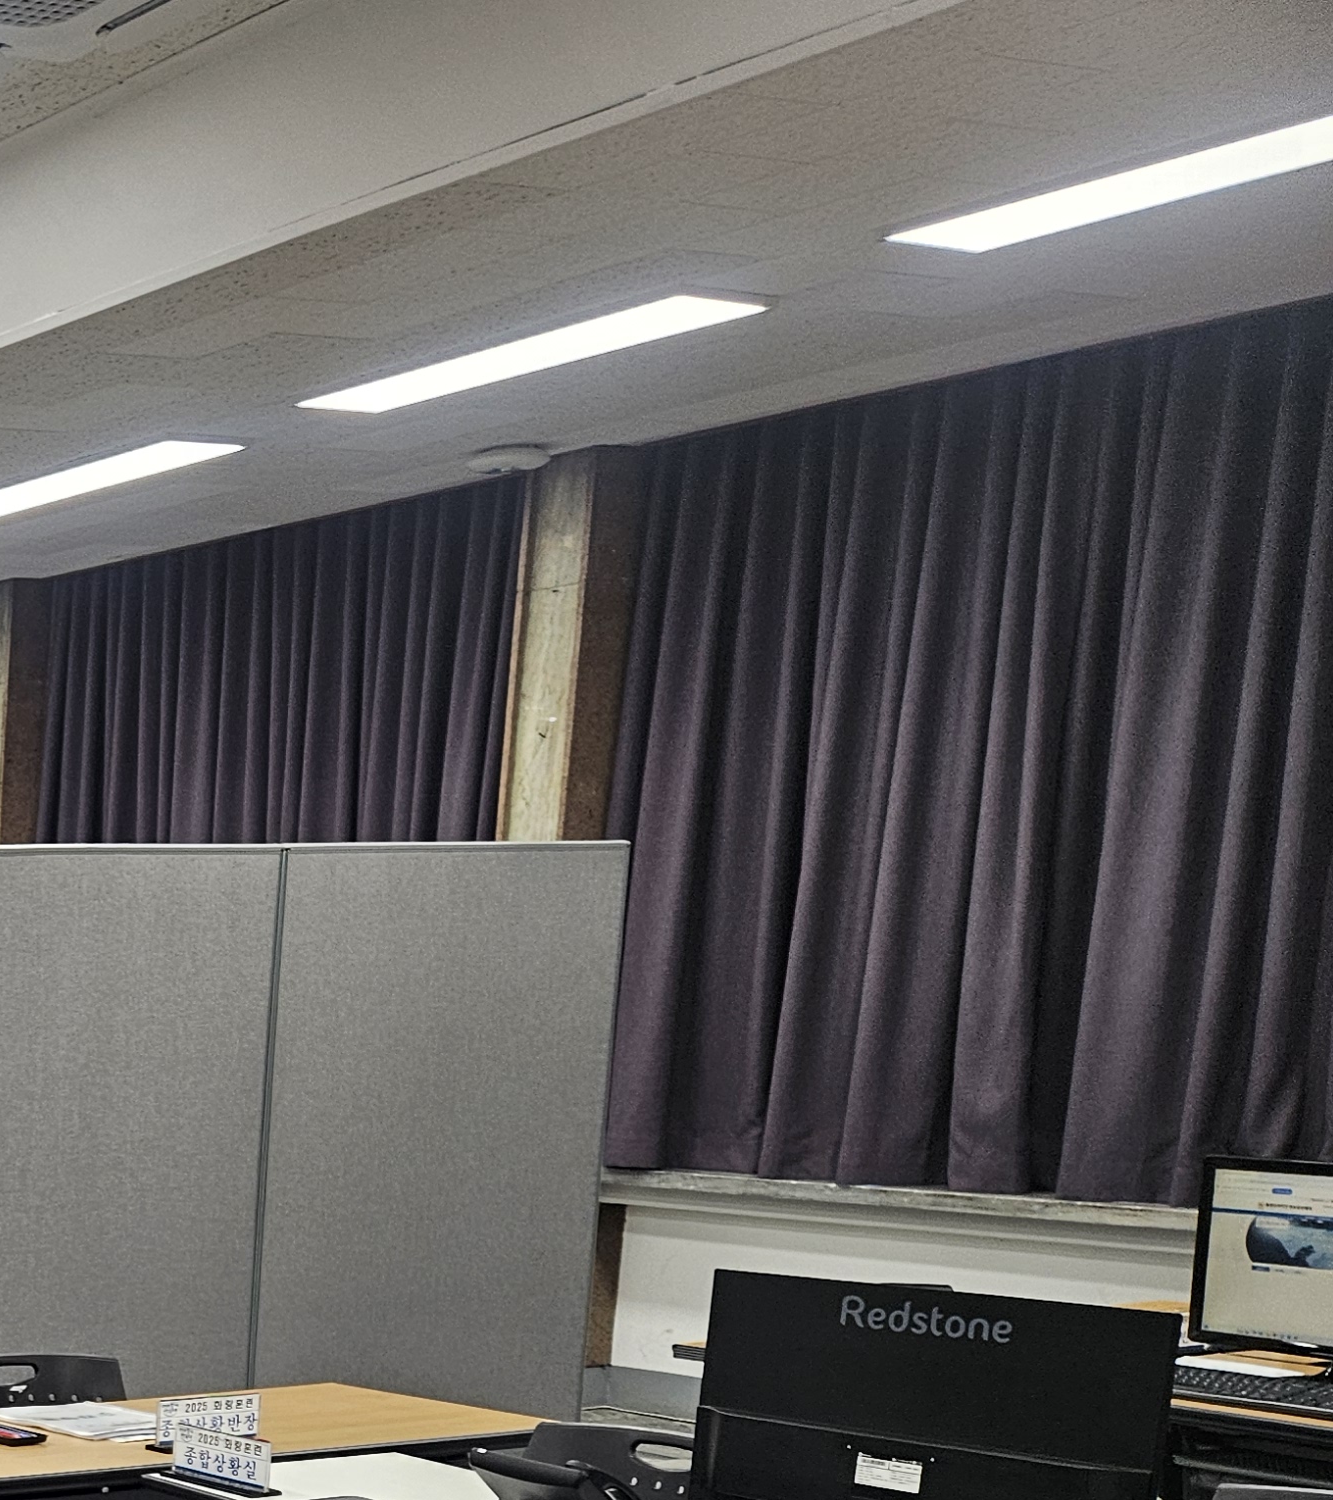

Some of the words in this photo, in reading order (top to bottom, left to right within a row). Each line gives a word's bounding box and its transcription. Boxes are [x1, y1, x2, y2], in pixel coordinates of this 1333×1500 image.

[839, 1295, 1013, 1343] Redstone
[185, 1402, 209, 1413] 2025
[198, 1433, 220, 1447] 2025
[184, 1446, 257, 1481] 종합상황실
